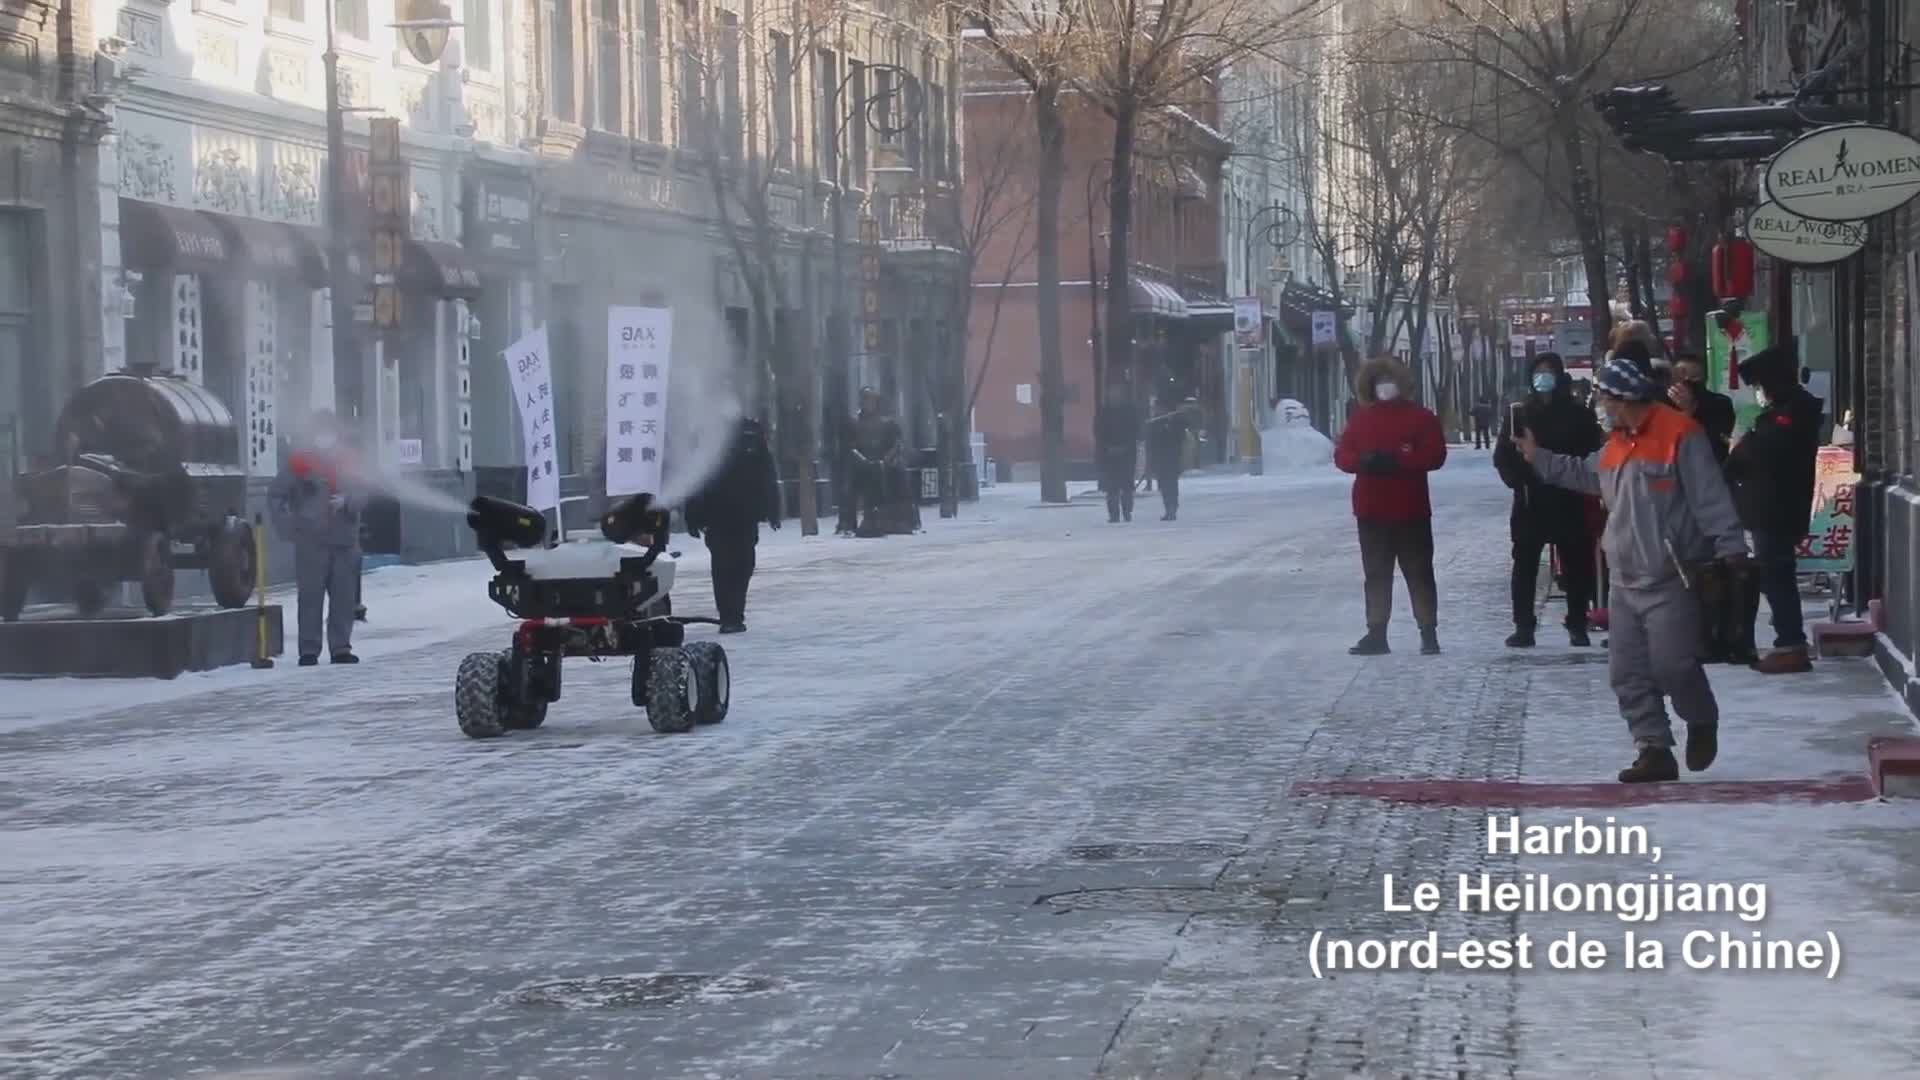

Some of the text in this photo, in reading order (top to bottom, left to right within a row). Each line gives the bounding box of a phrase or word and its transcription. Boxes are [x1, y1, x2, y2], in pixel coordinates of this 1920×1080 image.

[1777, 155, 1920, 187] REAL WOMEN
[1753, 217, 1797, 233] REAL
